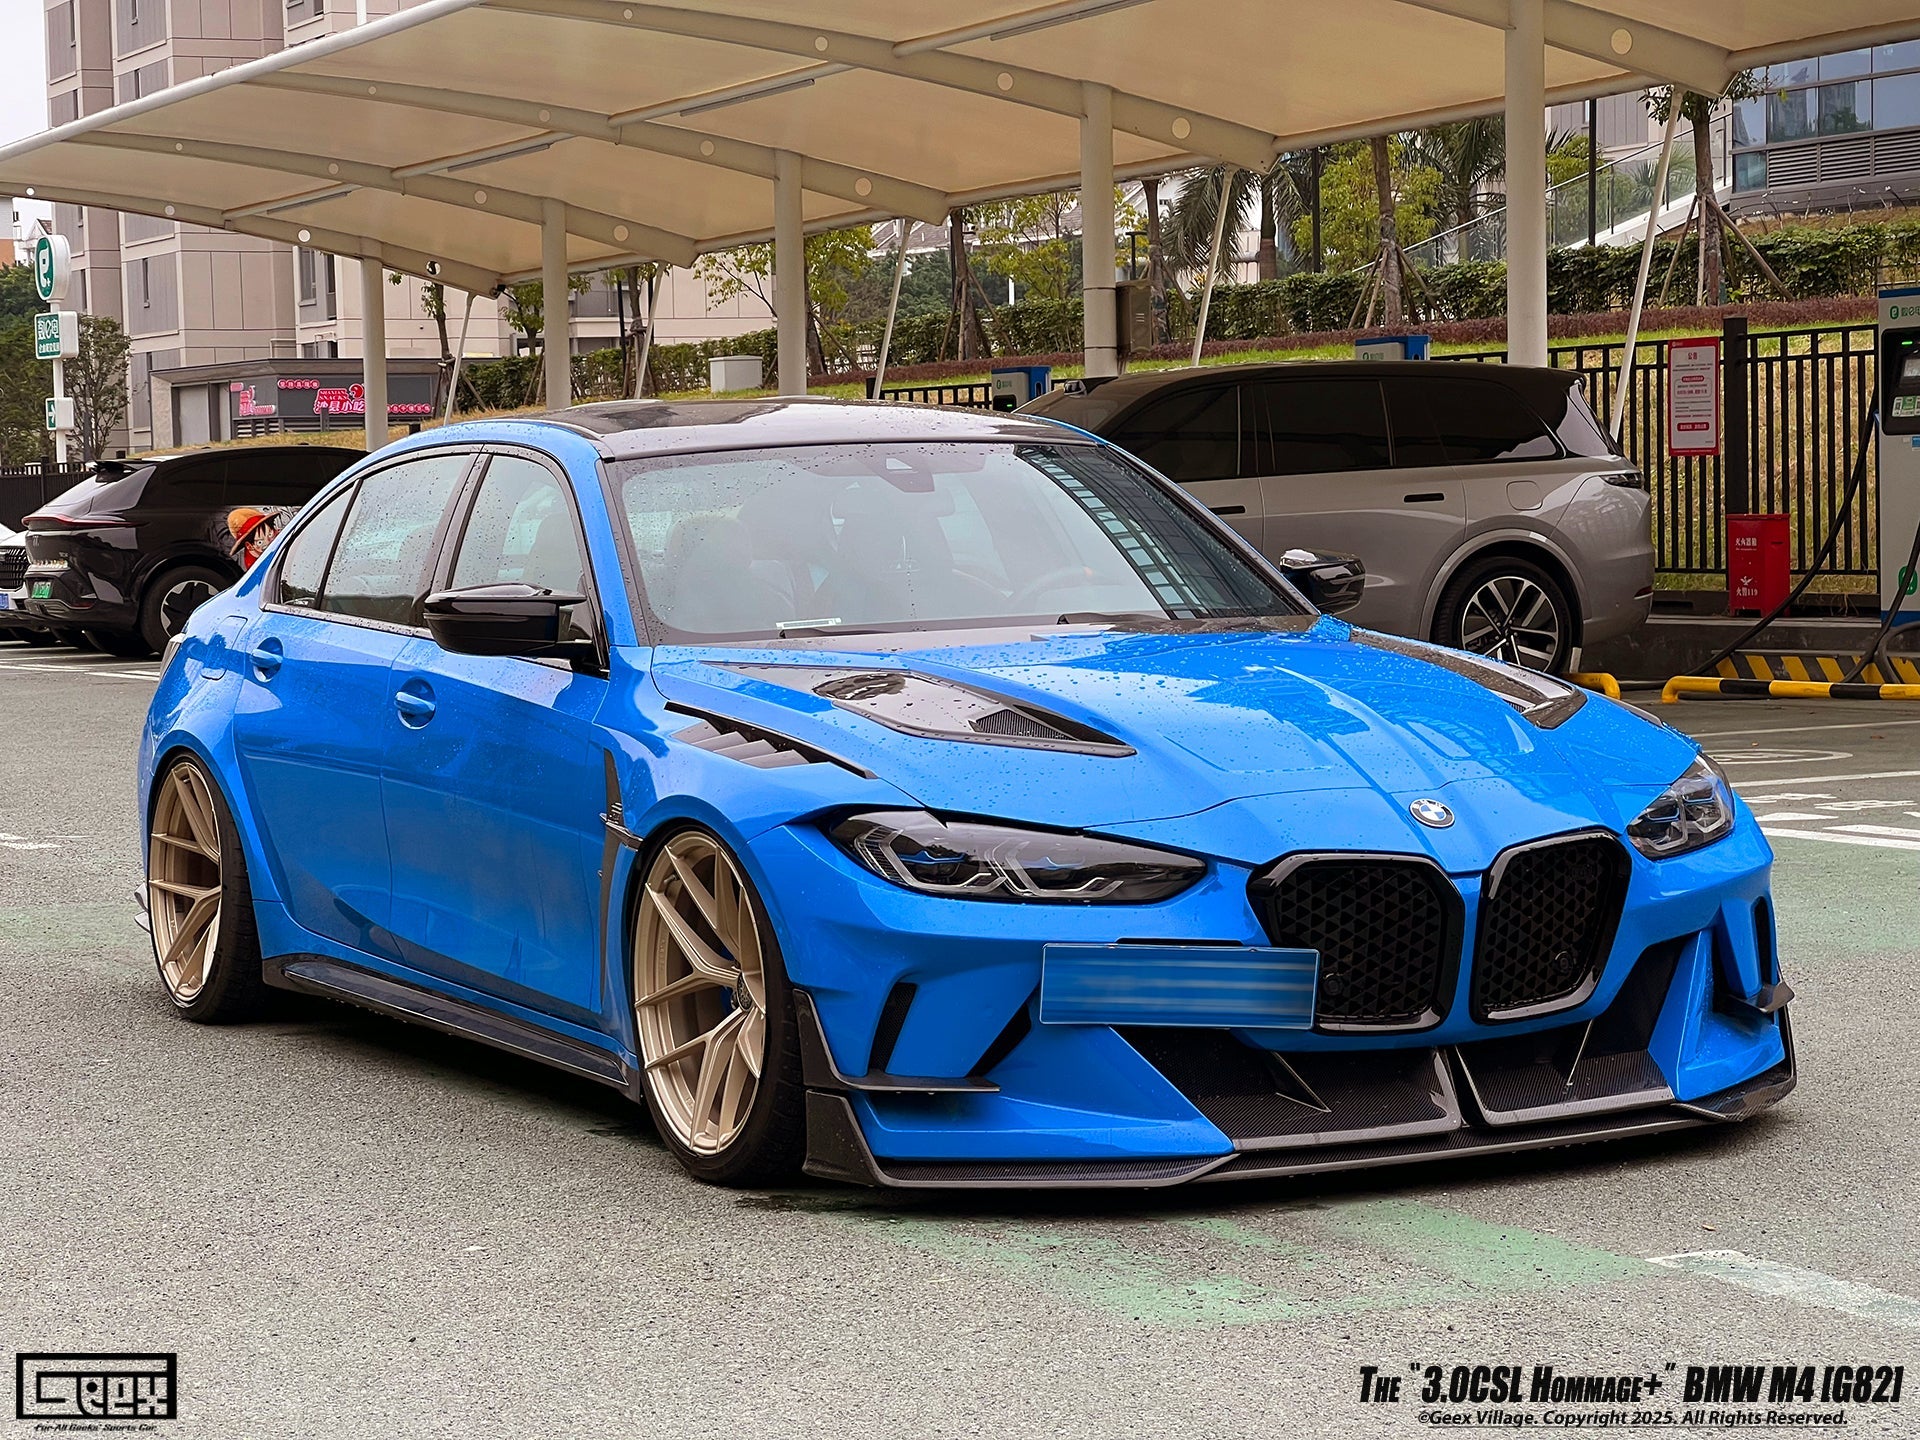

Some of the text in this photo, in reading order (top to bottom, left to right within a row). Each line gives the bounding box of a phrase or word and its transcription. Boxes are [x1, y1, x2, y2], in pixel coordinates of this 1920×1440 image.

[315, 400, 365, 412] 沙县小吃
[1735, 537, 1757, 547] 灭火器箱
